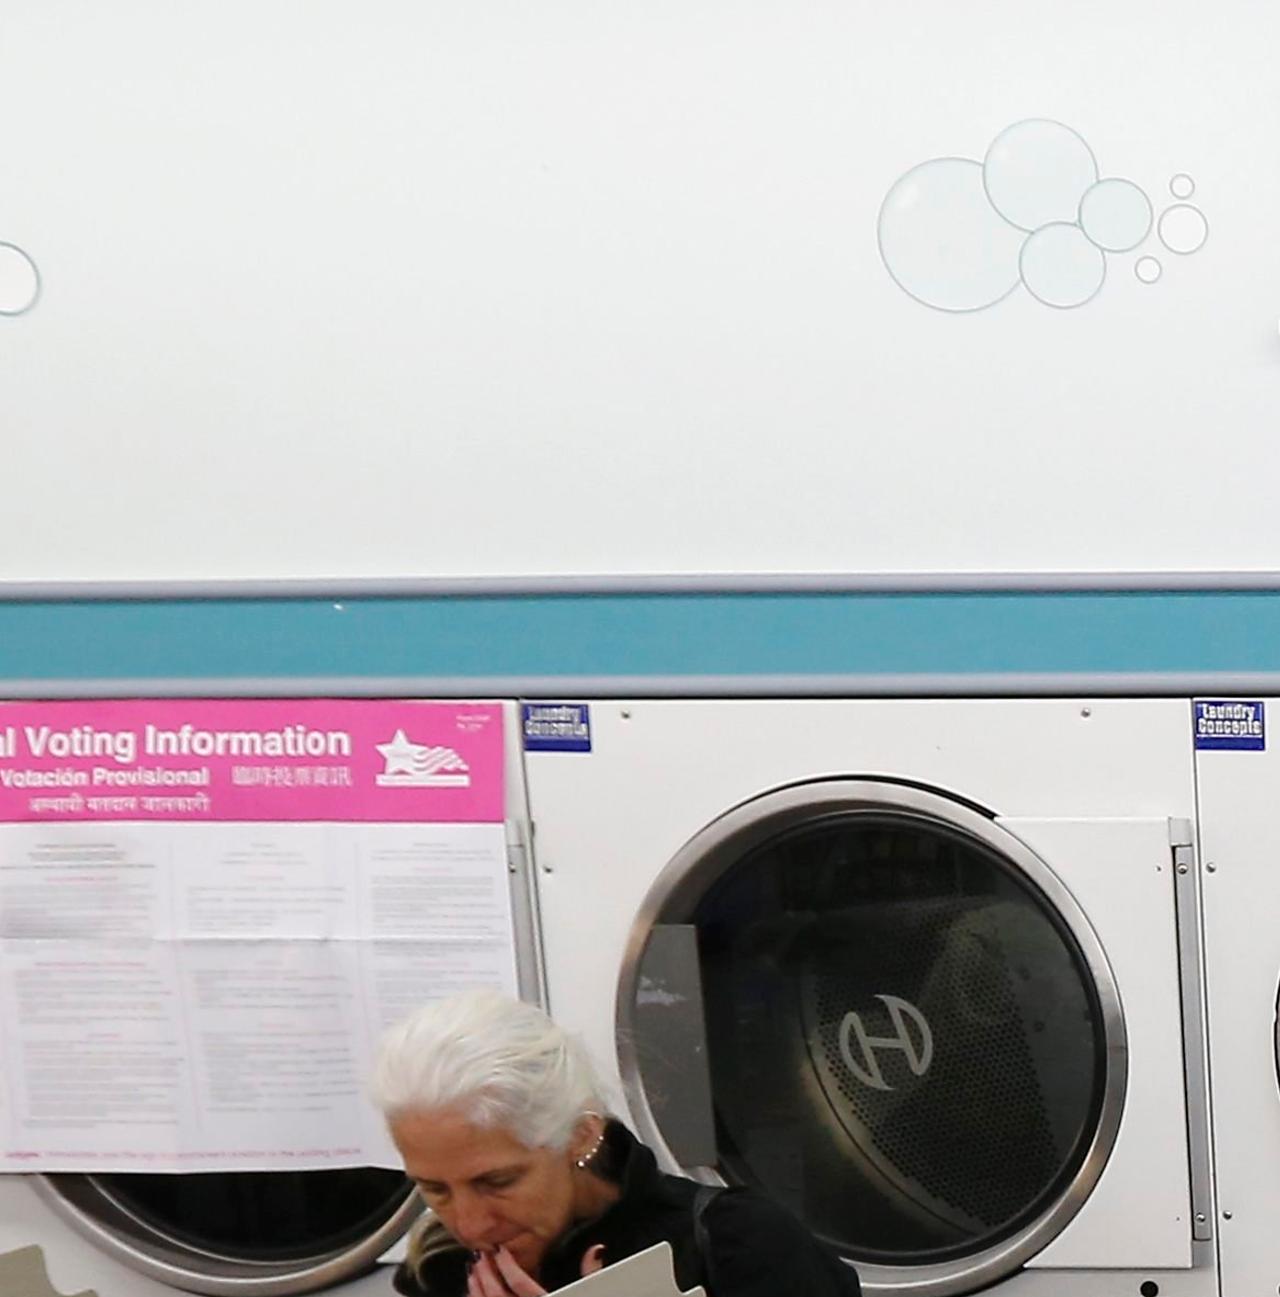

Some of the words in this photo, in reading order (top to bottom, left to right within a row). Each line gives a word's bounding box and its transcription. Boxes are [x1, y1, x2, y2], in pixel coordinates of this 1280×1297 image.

[1202, 703, 1255, 720] Laundry
[24, 725, 135, 763] Voting
[145, 724, 351, 757] Information
[1, 768, 88, 787] Votación
[93, 766, 209, 786] Provisional
